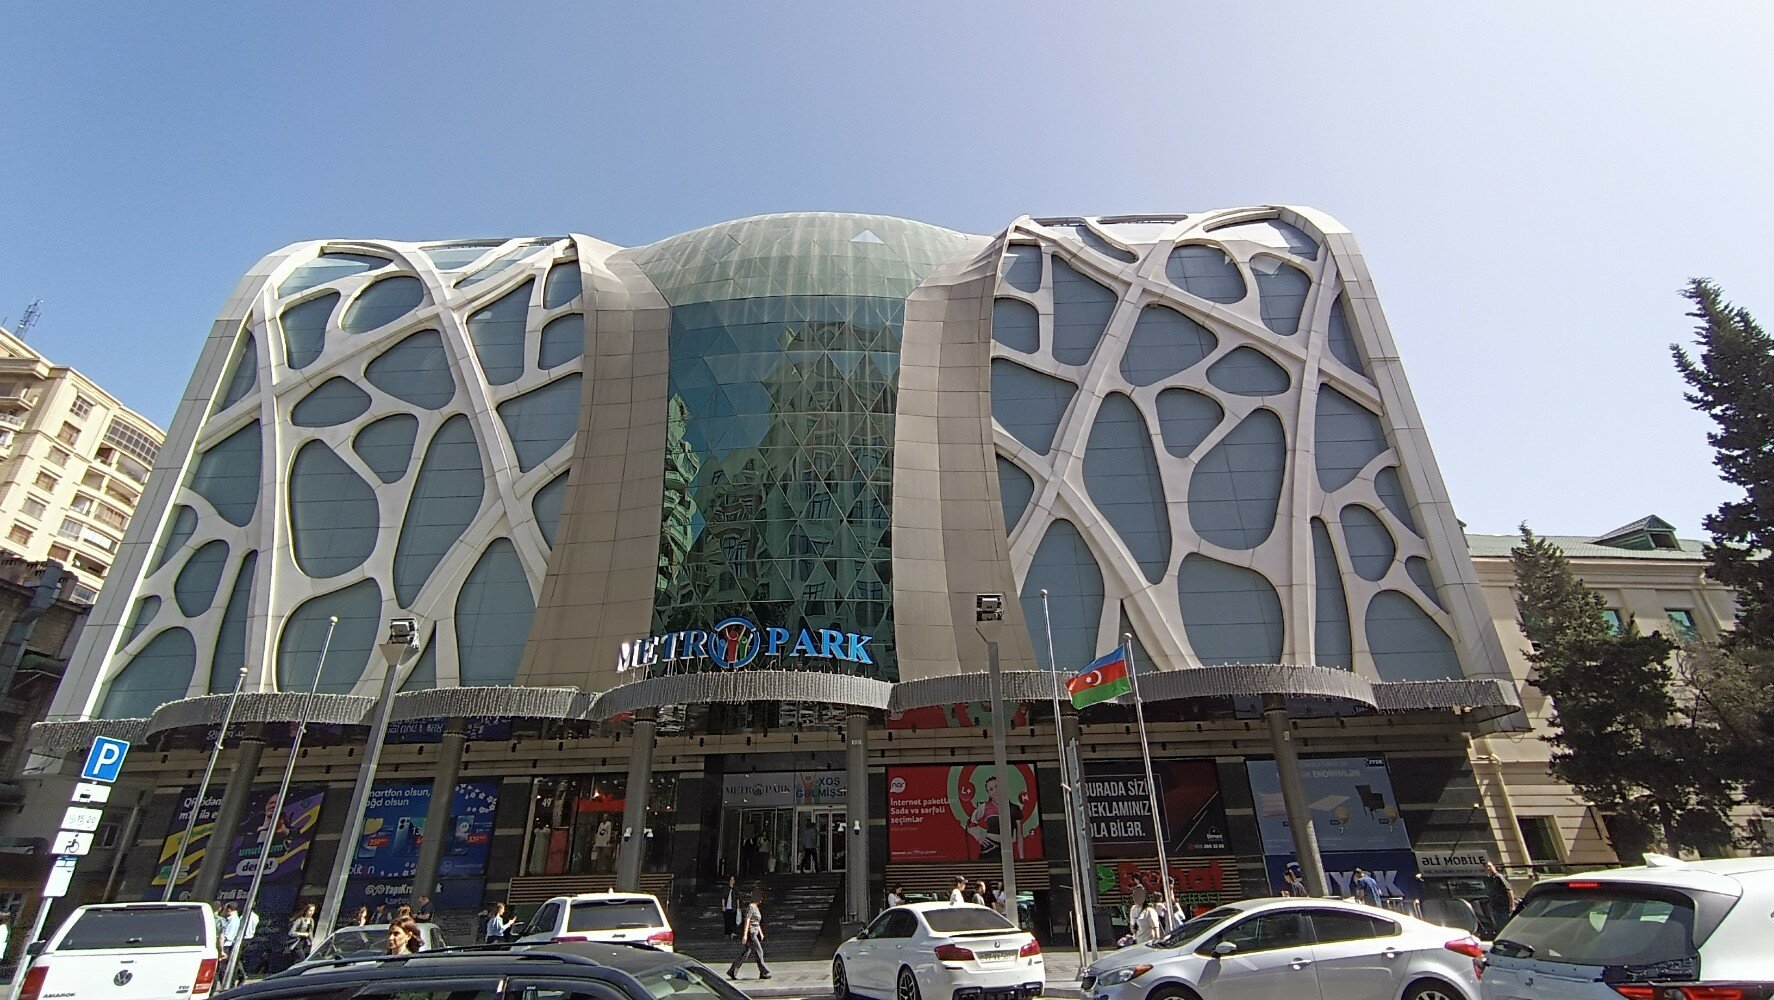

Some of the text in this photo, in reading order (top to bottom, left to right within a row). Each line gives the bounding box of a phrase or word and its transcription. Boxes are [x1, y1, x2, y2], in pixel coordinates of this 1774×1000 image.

[765, 626, 873, 664] PARK
[93, 743, 119, 775] P
[384, 797, 409, 807] olsun
[1421, 854, 1441, 866] ƏLİ
